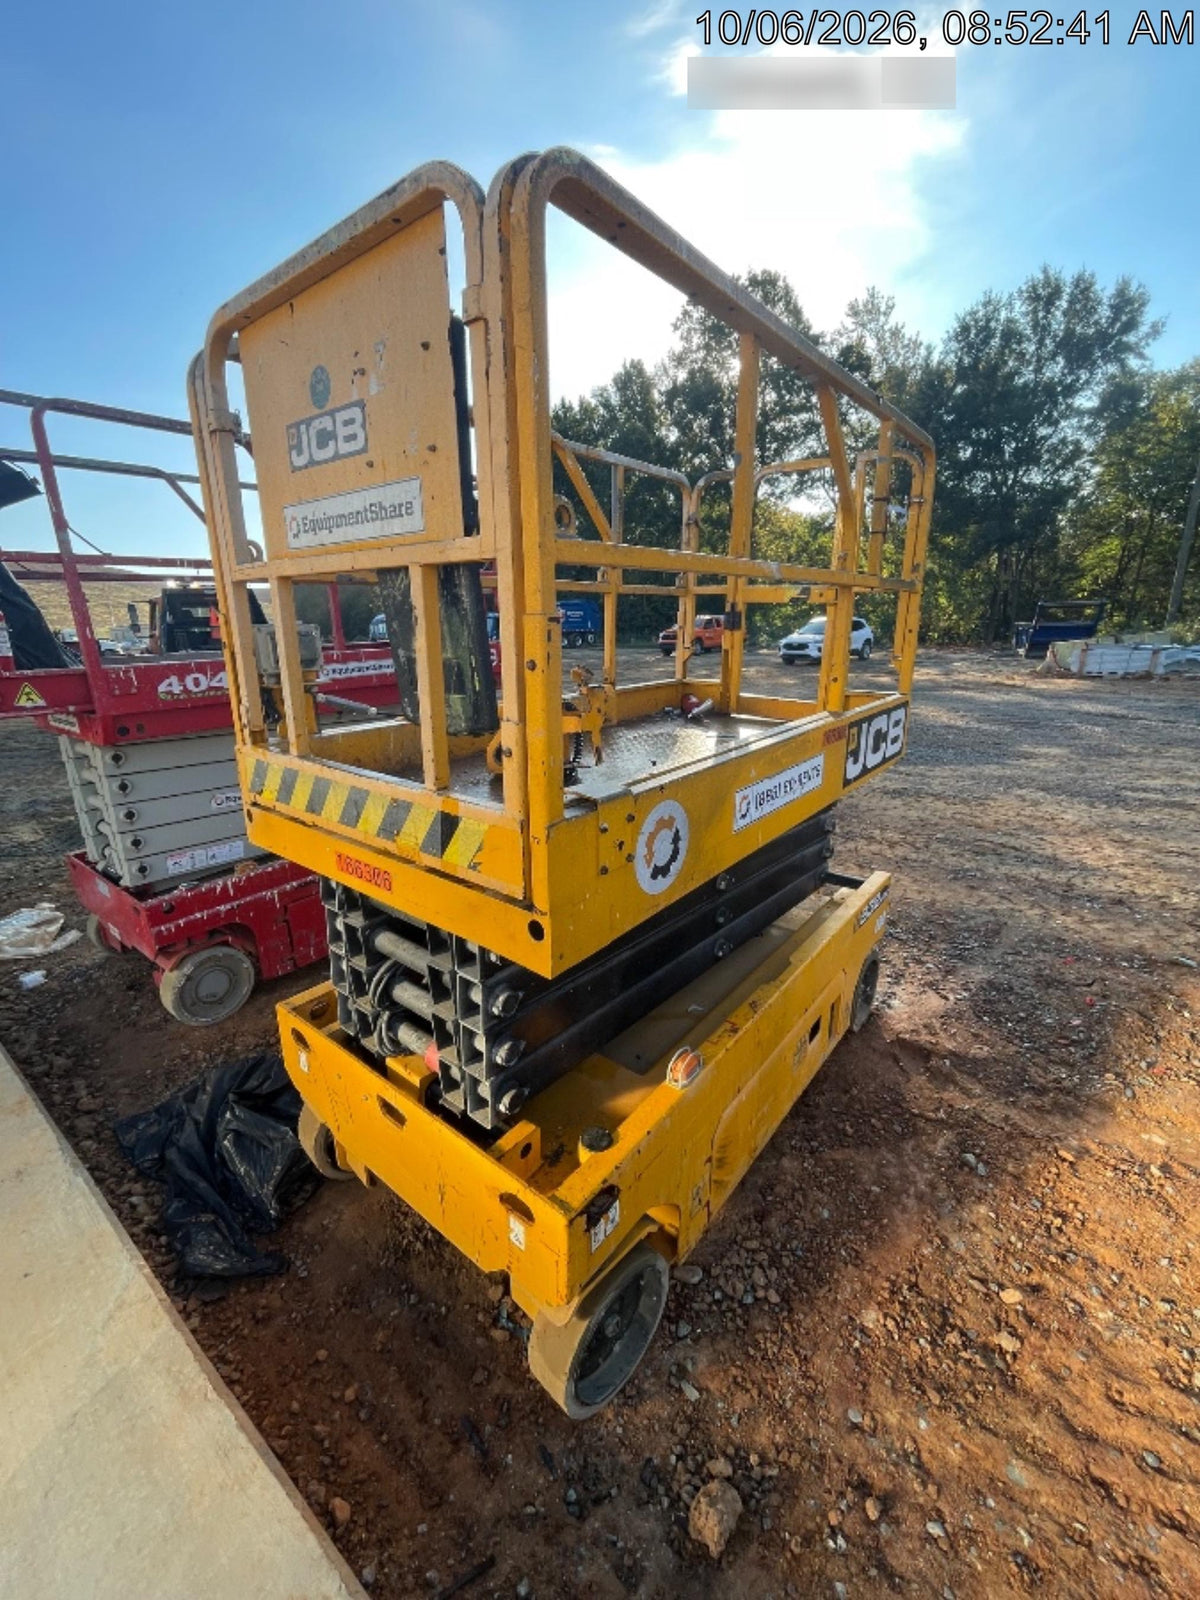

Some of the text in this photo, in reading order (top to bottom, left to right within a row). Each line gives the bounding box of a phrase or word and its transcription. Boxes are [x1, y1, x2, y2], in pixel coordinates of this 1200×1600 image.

[290, 406, 366, 468] JCB
[301, 500, 415, 537] EquipmentShare
[845, 706, 907, 781] JCB
